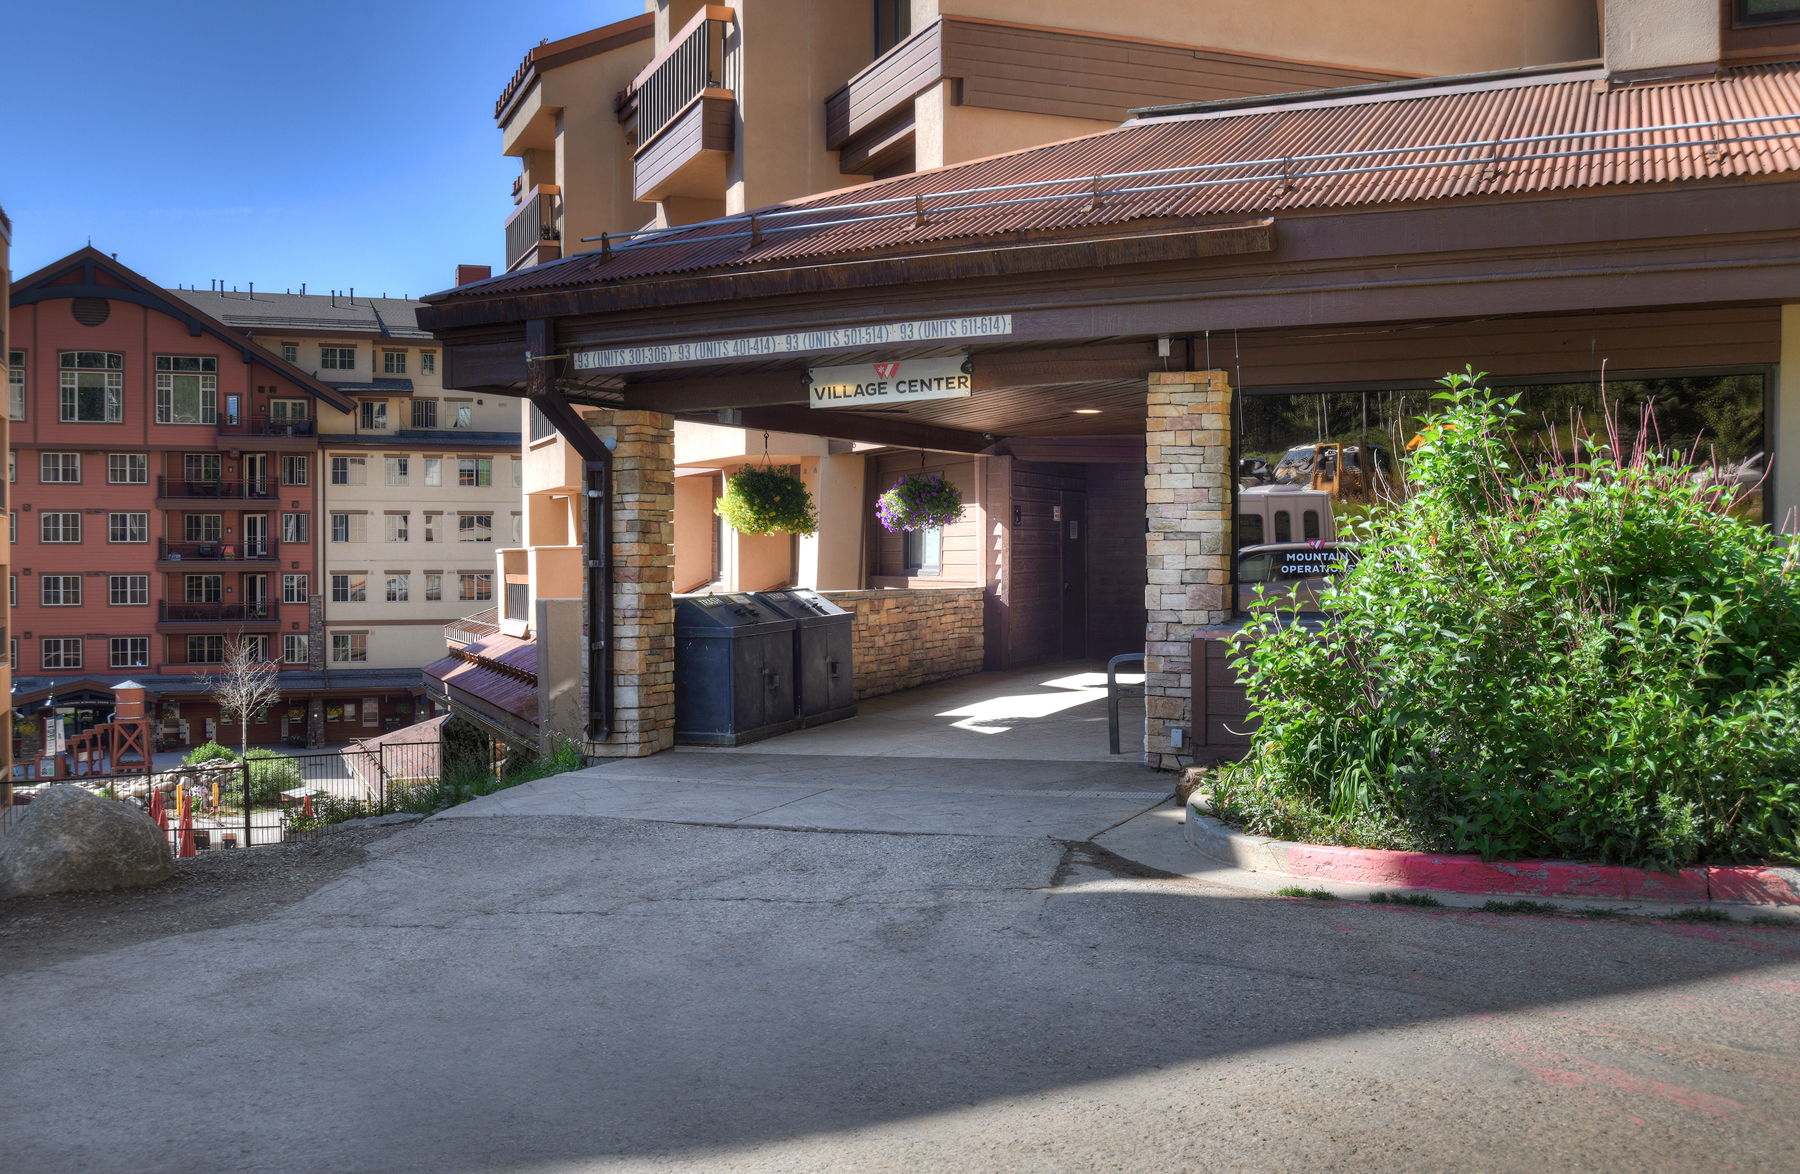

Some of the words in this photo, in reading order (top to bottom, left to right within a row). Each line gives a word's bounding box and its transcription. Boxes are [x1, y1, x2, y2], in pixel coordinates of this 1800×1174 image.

[577, 353, 590, 368] 93
[592, 350, 626, 368] (UNITS
[628, 345, 672, 365] 301-306)
[678, 344, 691, 361] 93
[694, 340, 729, 361] (UNITS
[732, 335, 776, 355] 401-414)
[785, 334, 799, 351] 93
[802, 330, 840, 350] (UNITS
[843, 325, 889, 346] 501-514)
[900, 323, 914, 341] 93
[918, 319, 957, 340] (UNITS
[961, 315, 1007, 336] 611-614)
[814, 381, 888, 400] VILLAGE
[895, 375, 969, 394] CENTER
[1286, 553, 1348, 561] MOUNTAIN
